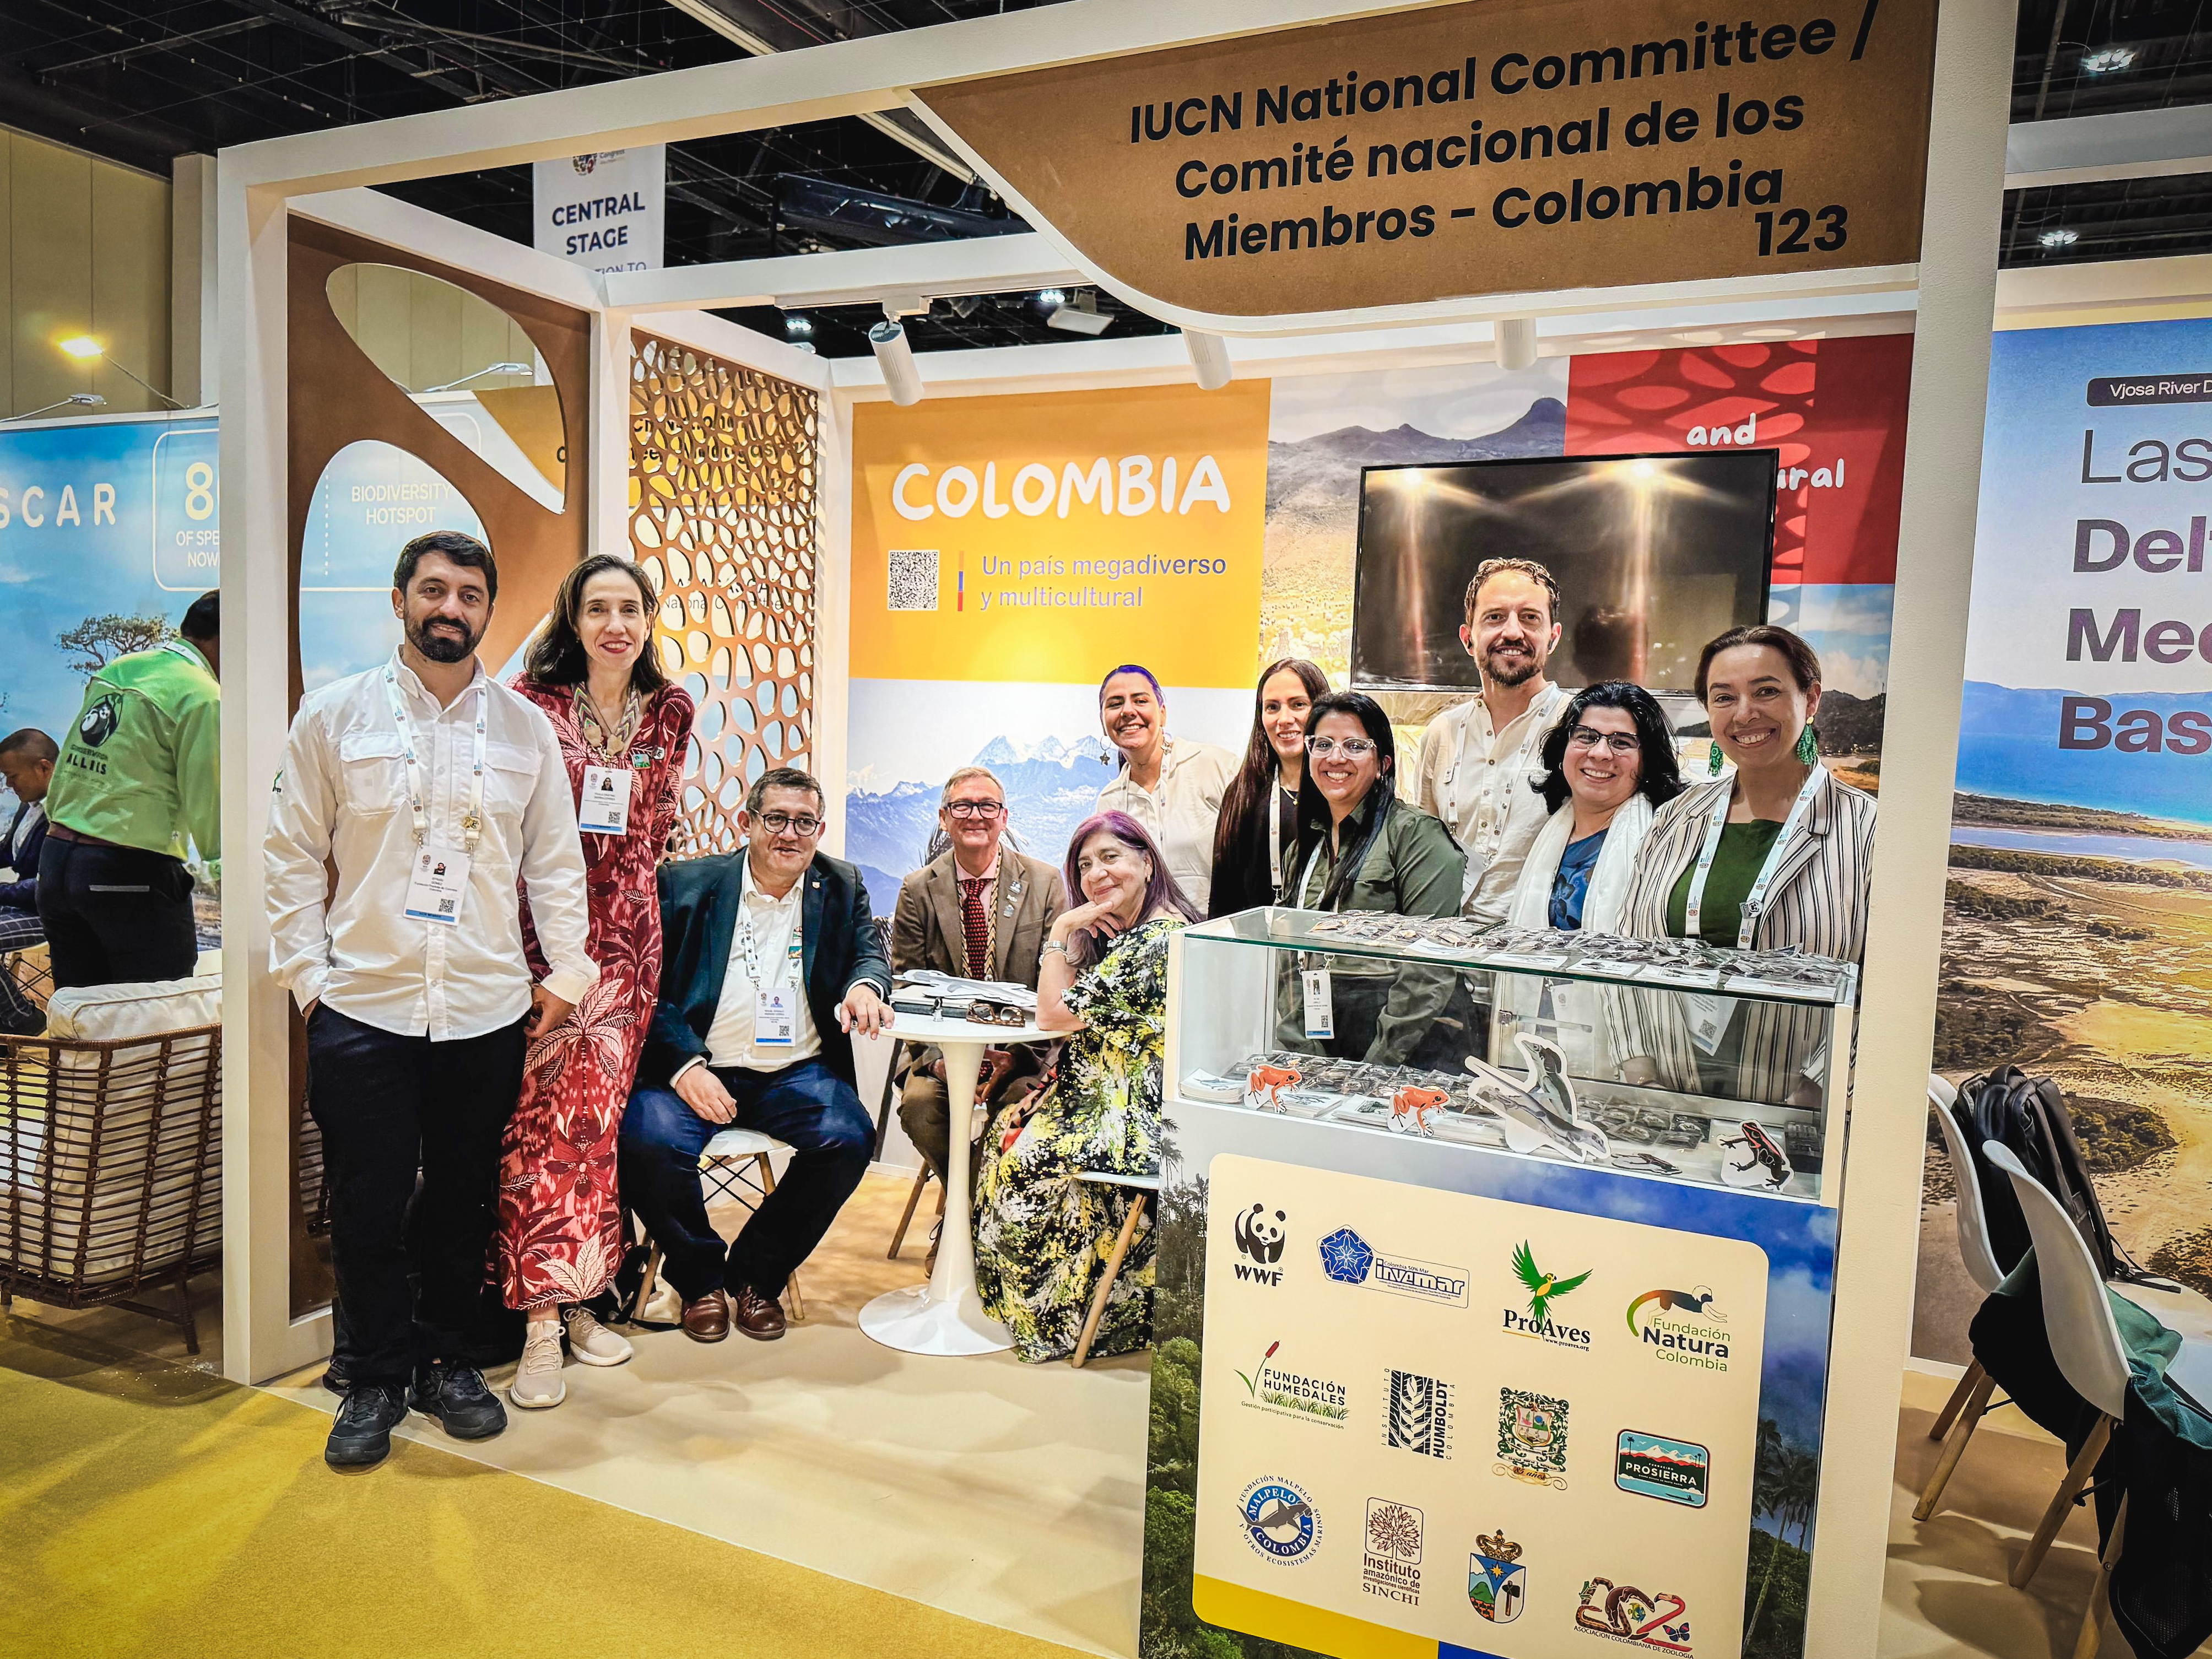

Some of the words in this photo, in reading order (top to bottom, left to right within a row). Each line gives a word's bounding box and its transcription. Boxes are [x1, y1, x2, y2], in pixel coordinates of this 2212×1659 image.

[1131, 91, 1242, 143] IUCN
[1256, 57, 1477, 127] National
[1491, 18, 1836, 95] Committee
[1176, 134, 1354, 198] Comité
[1367, 107, 1610, 177] nacional
[1625, 100, 1699, 148] de
[1715, 92, 1804, 138] los
[551, 191, 646, 226] CENTRAL
[1185, 204, 1436, 261] Miembros
[1492, 159, 1783, 229] Colombia
[566, 225, 628, 255] STAGE
[1755, 204, 1848, 257] 123
[2110, 383, 2155, 399] Vjosa
[2158, 381, 2203, 396] River
[1686, 412, 1756, 446] and
[2080, 429, 2212, 483] Las
[351, 482, 451, 502] BIODIVERSITY
[892, 454, 1231, 521] COLOMBIA
[366, 506, 436, 525] HOTSPOT
[176, 531, 193, 547] OF
[2073, 516, 2212, 573] Del
[187, 552, 219, 568] NOW
[982, 555, 1011, 575] Un
[1019, 554, 1065, 580] país
[1072, 554, 1227, 580] megadiverso
[980, 591, 992, 611] y
[999, 586, 1143, 607] multicultural
[2066, 608, 2212, 664] Me
[2058, 696, 2212, 755] Bas
[1234, 1263, 1284, 1287] WWF
[1376, 1257, 1465, 1295] invemar
[1384, 1261, 1407, 1270] Colombia
[1502, 1309, 1591, 1344] ProAves
[1653, 1317, 1730, 1342] Fundación
[1643, 1326, 1729, 1359] Natura
[1656, 1348, 1727, 1372] Colombia
[1263, 1379, 1345, 1406] HUMEDALES
[1264, 1368, 1345, 1396] FUNDACIÓN
[1381, 1368, 1390, 1446] INSTITUTO
[1433, 1379, 1448, 1459] HUMBOLDT
[1446, 1384, 1456, 1460] COLOMBIA
[1625, 1461, 1697, 1486] PROSIERRA
[1239, 1474, 1274, 1503] FUNDACIÓN
[1248, 1487, 1297, 1516] MALPELO
[1277, 1476, 1313, 1503] MALPELO
[1256, 1523, 1312, 1554] COLOMBIA
[1313, 1508, 1323, 1548] MARINOS
[1243, 1533, 1265, 1558] OTROS
[1266, 1547, 1317, 1567] ECOSISTEMAS
[1363, 1568, 1408, 1586] amazónico
[1410, 1579, 1420, 1589] de
[1364, 1553, 1421, 1580] Instituto
[1362, 1582, 1420, 1607] SINCHI
[1573, 1625, 1610, 1640] ASOCIACION
[1610, 1634, 1652, 1650] COLOMBIANA
[1662, 1647, 1694, 1659] ZOOLOGIA
